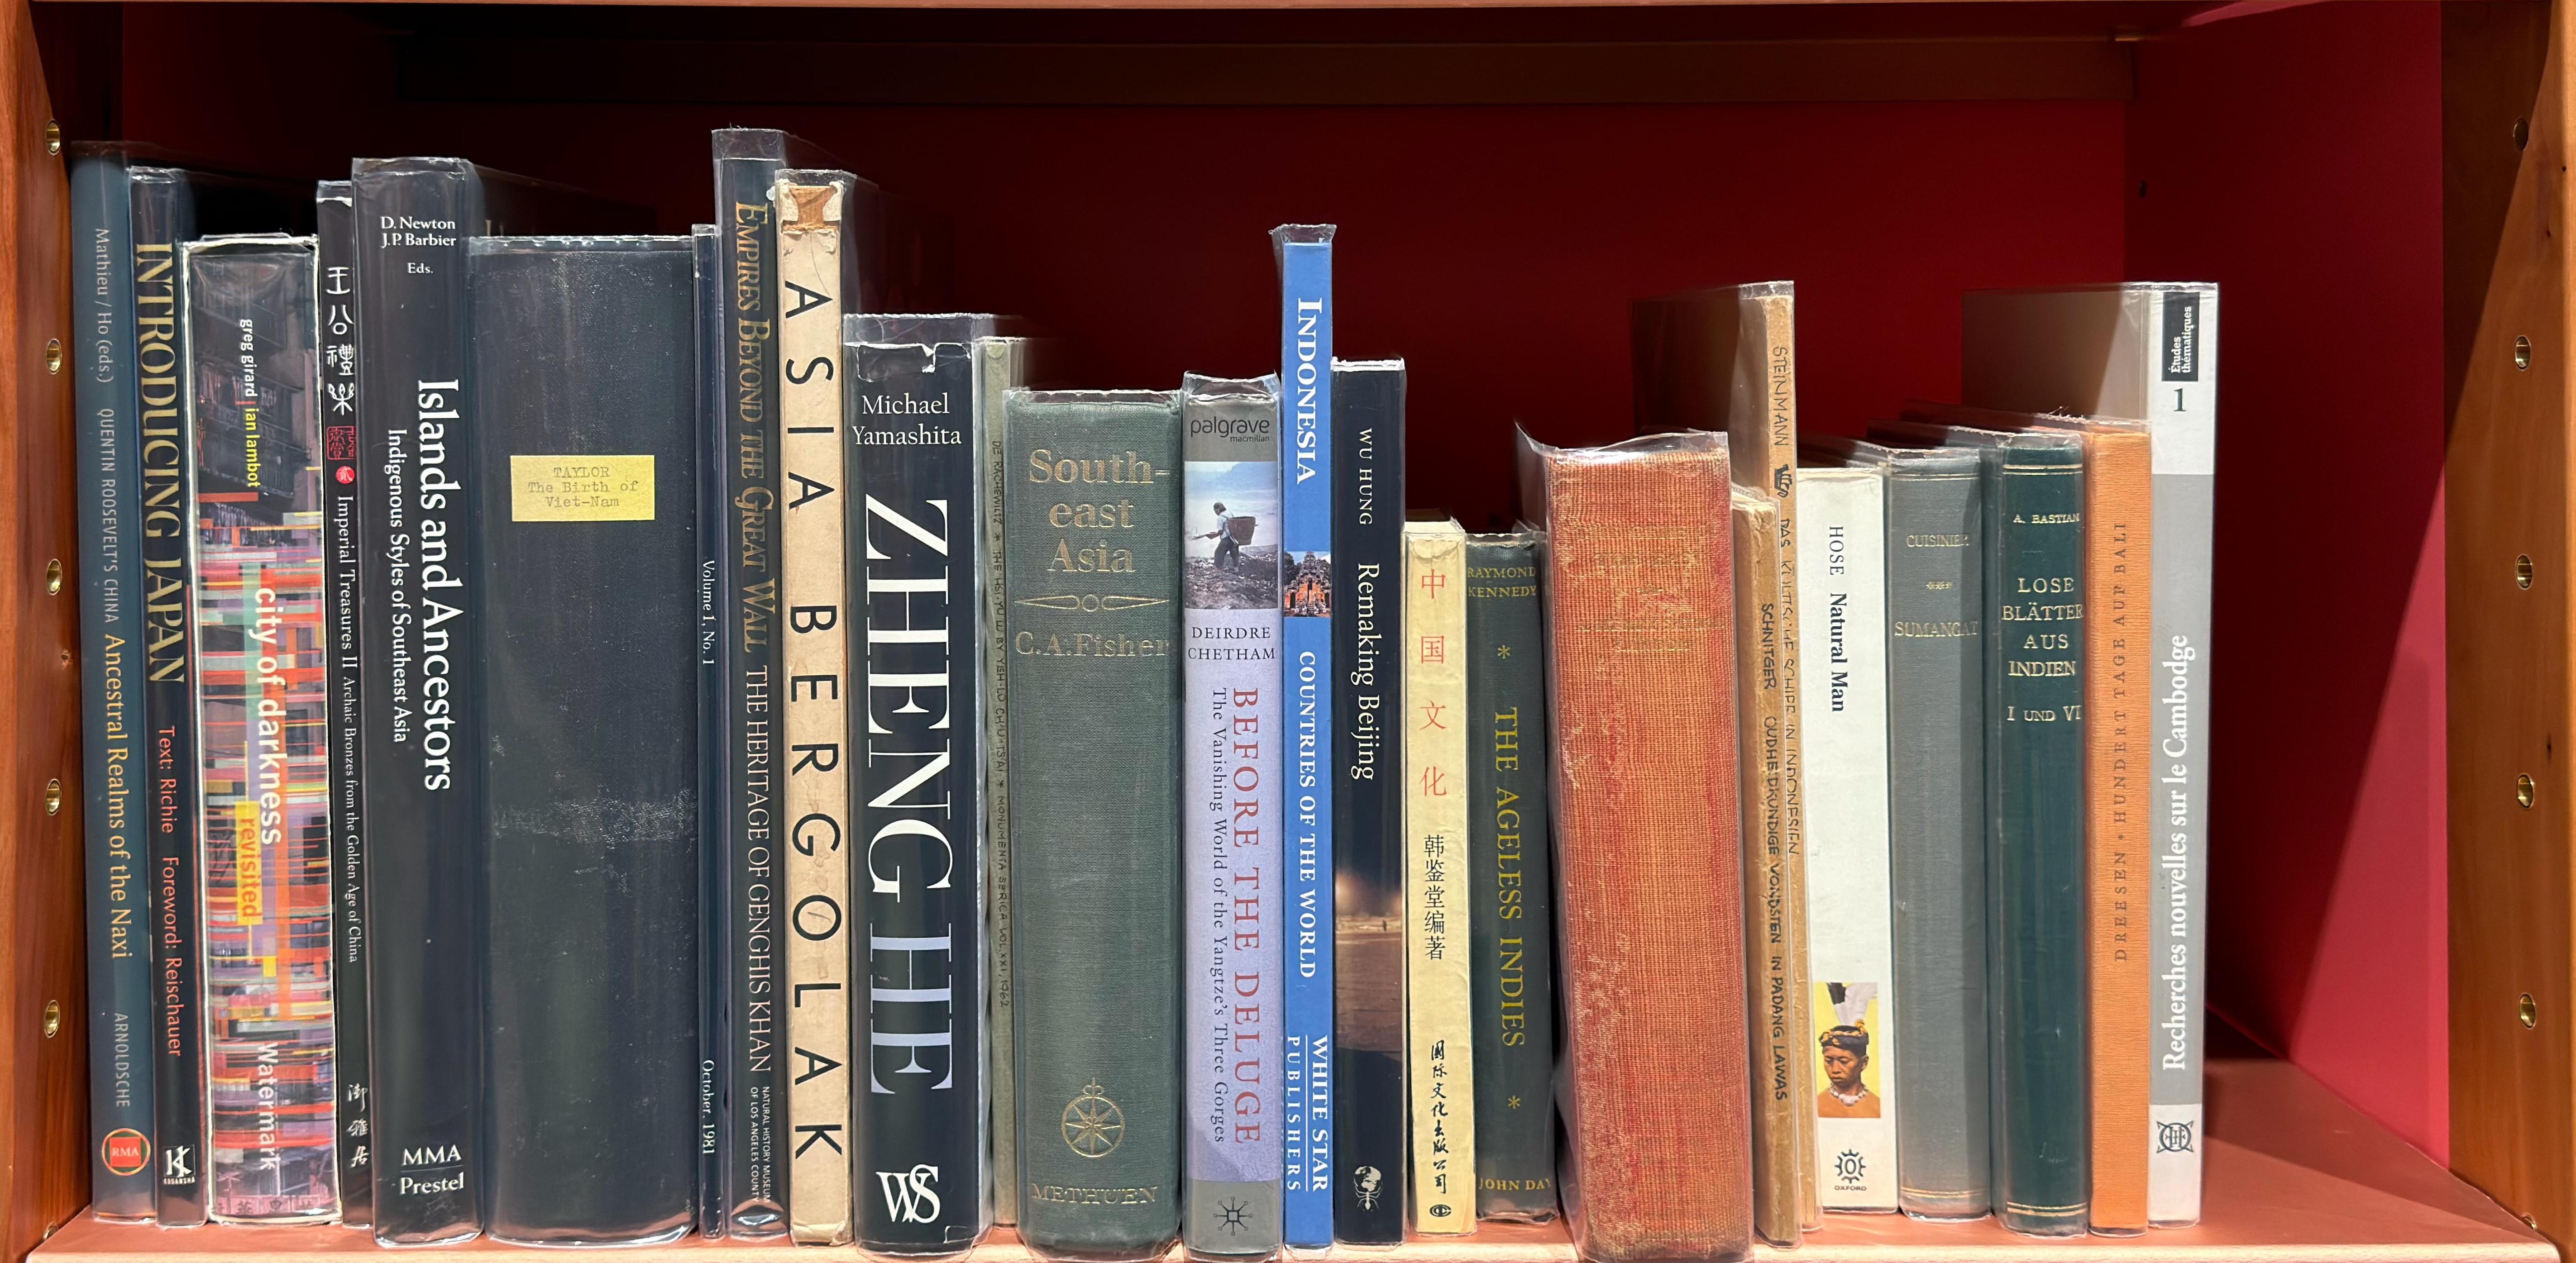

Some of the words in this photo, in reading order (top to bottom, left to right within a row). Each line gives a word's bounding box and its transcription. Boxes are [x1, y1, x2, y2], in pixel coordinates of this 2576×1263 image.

[381, 216, 397, 229] D.
[400, 216, 456, 230] Newton
[405, 233, 457, 247] Barbier
[96, 228, 112, 295] Mathieu
[407, 262, 434, 274] Eds.
[98, 312, 112, 334] Ho
[240, 319, 253, 351] greg
[2181, 306, 2194, 373] thématiques
[96, 338, 114, 383] (eds.)
[241, 356, 258, 397] girard
[2168, 336, 2181, 373] Études
[136, 243, 181, 538] INTRODUCING
[862, 392, 950, 415] Michael
[1297, 297, 1323, 485] INDONESIA
[1773, 346, 1789, 447] STEINMANN
[2173, 387, 2187, 412] 1
[97, 409, 115, 472] QUENTIN
[245, 408, 259, 431] ian
[417, 379, 461, 509] Islands
[852, 423, 962, 445] Yamashita
[1190, 416, 1270, 438] palgrave
[1229, 434, 1270, 443] macmillan
[1359, 428, 1372, 460] WU
[245, 434, 261, 487] lambot
[384, 429, 407, 528] Indigenous
[554, 467, 610, 478] TAYLOR
[740, 429, 765, 479] THE
[1029, 448, 1170, 483] South-
[528, 481, 554, 493] The
[562, 481, 610, 493] Birth
[620, 480, 639, 492] of
[545, 496, 620, 507] Viet-Nam
[1359, 468, 1373, 525] HUNG
[101, 479, 118, 572] ROOSEVELT'S
[334, 496, 356, 563] Imperial
[1049, 498, 1134, 528] east
[2031, 513, 2080, 524] BASTIAN
[386, 534, 410, 586] Styles
[421, 519, 464, 591] and
[1047, 538, 1136, 573] Asia
[1467, 567, 1536, 579] RAYMOND
[1829, 526, 1845, 576] HOSE
[2114, 524, 2127, 574] BALI
[104, 578, 119, 623] CHINA
[339, 569, 356, 649] Treasures
[392, 590, 411, 609] of
[702, 560, 715, 611] Volume
[1468, 586, 1537, 598] KENNEDY
[2017, 577, 2074, 593] LOSE
[2113, 586, 2127, 627] AUF
[143, 560, 185, 682] JAPAN
[248, 588, 282, 644] city
[1191, 626, 1271, 639] DEIRDRE
[1350, 563, 1382, 687] Remaking
[1830, 592, 1848, 664] Natural
[1894, 620, 1979, 638] SUMANGAT
[2001, 602, 2084, 621] BLÄTTER
[342, 656, 358, 668] II
[392, 613, 412, 702] Southeast
[702, 630, 715, 654] No.
[1188, 647, 1276, 660] CHETHAM
[1761, 602, 1777, 690] SCHNITGER
[2023, 634, 2069, 649] AUS
[105, 634, 128, 740] Ancestral
[258, 660, 286, 686] of
[746, 665, 768, 714] THE
[1419, 568, 1447, 797] 中国文化
[1831, 671, 1848, 712] Man
[2007, 661, 2076, 677] INDIEN
[2113, 639, 2126, 699] TAGE
[344, 677, 357, 724] Archaic
[422, 597, 464, 791] Ancestors
[865, 493, 953, 903] ZHENG
[1213, 687, 1227, 720] The
[2023, 710, 2056, 722] UND
[2162, 635, 2195, 758] Cambodge
[393, 706, 413, 742] Asia
[1299, 651, 1316, 788] COUNTRIES
[1350, 694, 1380, 780] Beijing
[1495, 706, 1518, 772] THE
[158, 725, 176, 770] Text:
[257, 699, 287, 845] darkness
[344, 728, 358, 776] Bronzes
[1209, 726, 1227, 812] Vanishing
[1233, 687, 1259, 848] BEFORE
[2113, 710, 2127, 824] HUNDERT
[108, 748, 129, 829] Realms
[345, 781, 359, 808] from
[747, 720, 769, 840] HERITAGE
[2161, 764, 2187, 784] le
[160, 778, 177, 834] Richie
[346, 812, 359, 830] the
[1300, 796, 1316, 826] OF
[2171, 790, 2187, 827] sur
[109, 837, 130, 859] of
[347, 835, 360, 879] Golden
[996, 796, 1007, 871] MONUMENTA
[1213, 818, 1228, 870] World
[1300, 833, 1316, 882] THE
[1496, 786, 1523, 920] AGELESS
[110, 866, 131, 901] the
[239, 818, 262, 917] revisited
[748, 846, 770, 877] OF
[790, 605, 843, 1159] BERGOLAK
[2161, 832, 2187, 937] nouvelles
[162, 857, 182, 949] Foreword:
[344, 883, 360, 907] Age
[999, 877, 1008, 920] SERICA
[1214, 877, 1228, 897] of
[1234, 867, 1260, 951] THE
[1424, 834, 1446, 960] 韩鉴堂编著
[2114, 853, 2127, 962] DREESEN
[110, 909, 133, 958] Naxi
[349, 910, 361, 924] of
[748, 885, 771, 994] GENGHIS
[1214, 901, 1228, 929] the
[1300, 888, 1316, 978] WORLD
[349, 926, 362, 963] China
[1210, 935, 1228, 1015] Yangtze's
[1499, 938, 1525, 1047] INDIES
[165, 958, 184, 1056] Reischauer
[870, 922, 952, 1094] HE
[1771, 977, 1785, 1039] PADANG
[2161, 944, 2187, 1071] Recherches
[115, 1012, 130, 1107] ARNOLDSCHE
[749, 1001, 771, 1072] KHAN
[1214, 1023, 1229, 1074] Three
[1234, 971, 1261, 1144] DELUGE
[1312, 1034, 1328, 1120] WHITE
[1773, 1045, 1788, 1101] LAWAS
[257, 1042, 281, 1170] Watermark
[750, 1101, 759, 1119] LOS
[762, 1087, 770, 1124] NATURAL
[1210, 1082, 1228, 1143] Gorges
[1287, 1036, 1301, 1191] PUBLISHERS
[112, 1147, 139, 1158] RMA
[401, 1144, 462, 1166] MMA
[702, 1123, 715, 1154] 1981
[750, 1121, 759, 1162] ANGELES
[762, 1127, 771, 1162] HISTORY
[1312, 1129, 1329, 1192] STAR
[399, 1171, 464, 1195] Prestel
[1031, 1183, 1159, 1205] METHUEN
[1479, 1177, 1520, 1191] JOHN
